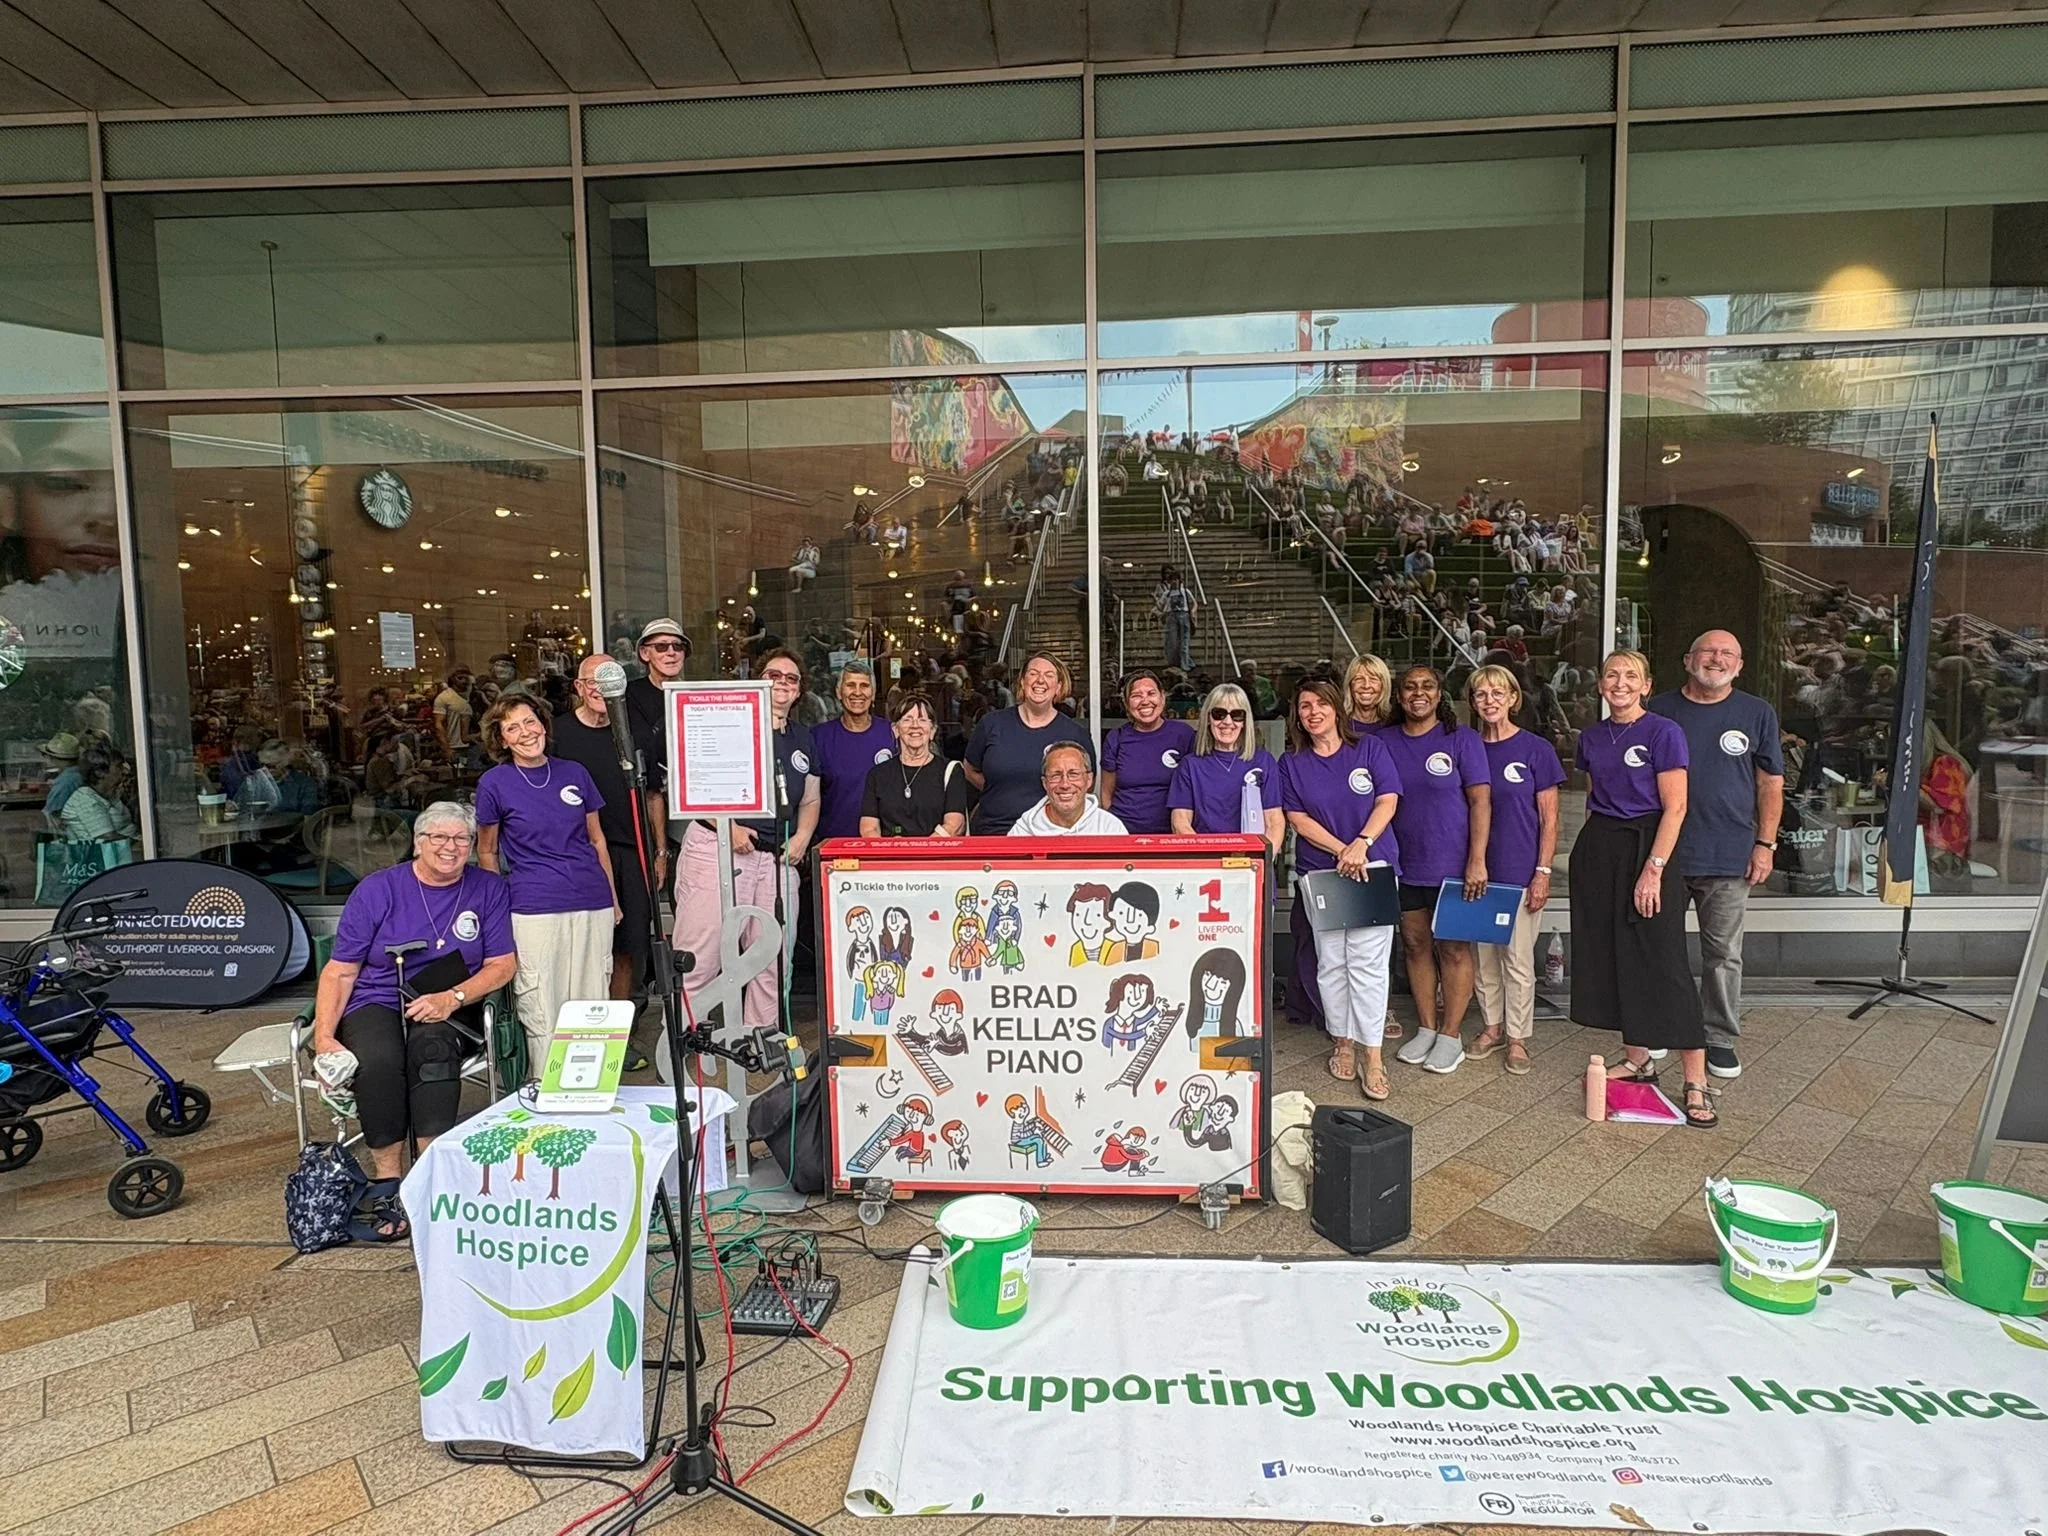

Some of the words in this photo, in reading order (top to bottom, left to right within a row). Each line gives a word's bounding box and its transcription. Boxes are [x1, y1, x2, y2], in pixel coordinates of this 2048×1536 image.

[62, 862, 97, 876] M&S
[854, 882, 884, 891] Tickle
[886, 882, 903, 891] the
[905, 882, 940, 891] Ivories
[113, 913, 245, 928] NNECTEDVOICES
[1198, 925, 1244, 934] LIVERPOOL
[105, 944, 164, 954] SOUTHPORT
[167, 944, 222, 954] LIVERPOOL
[224, 944, 276, 955] ORMSKIRK
[124, 967, 215, 977] nnectedvoices.co.uk
[991, 985, 1078, 1009] BRAD
[973, 1017, 1097, 1042] KELLA'S
[987, 1049, 1083, 1074] PIANO
[430, 1193, 618, 1231] Woodlands
[457, 1228, 589, 1270] Hospice
[1366, 1280, 1388, 1289] In
[1392, 1276, 1419, 1287] aid
[1426, 1281, 1449, 1291] of
[1356, 1322, 1502, 1336] Woodlands
[1383, 1335, 1491, 1351] Hospice
[939, 1366, 1318, 1418] Supporting
[1325, 1371, 1731, 1414] Woodlands
[1727, 1375, 2048, 1425] Hospice
[1348, 1418, 1445, 1432] Woodlands
[1448, 1421, 1519, 1434] Hospice
[1521, 1421, 1611, 1436] Charitable
[1612, 1424, 1662, 1436] Trust
[1390, 1433, 1637, 1451] www.woodlandshospice.org
[1364, 1450, 1426, 1461] Registered
[1428, 1450, 1468, 1463] charity
[1546, 1453, 1603, 1466] Company
[1289, 1463, 1433, 1480] /woodlandshospice
[1465, 1469, 1607, 1483] @wearewoodlands
[1642, 1471, 1773, 1487] wearewoodlands
[1484, 1498, 1510, 1510] FR
[1522, 1505, 1597, 1515] REGULATOR
